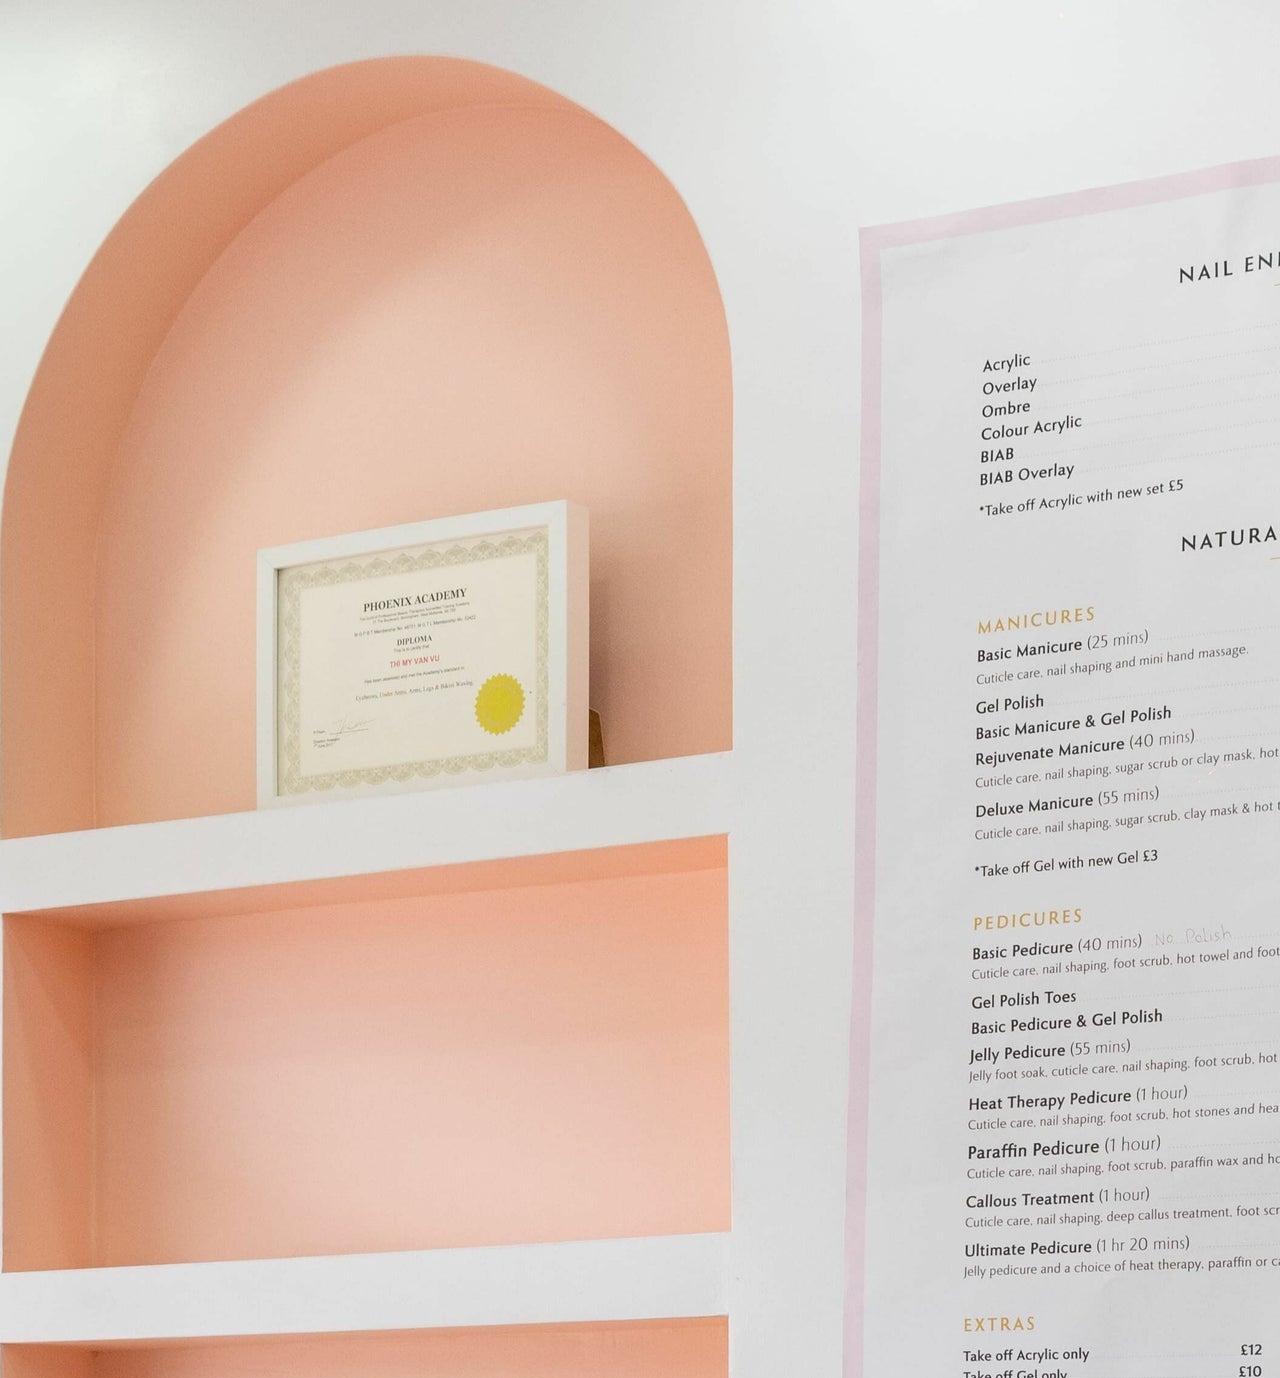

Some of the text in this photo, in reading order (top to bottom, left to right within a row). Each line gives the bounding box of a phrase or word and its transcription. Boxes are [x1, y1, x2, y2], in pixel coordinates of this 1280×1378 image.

[1179, 260, 1234, 284] NAIL
[982, 353, 1031, 374] Acrylic
[982, 376, 1038, 396] Overlay
[982, 400, 1031, 418] Ombre
[981, 415, 1082, 441] Colour Acrylic
[980, 447, 1014, 464] BIAB
[980, 462, 1075, 486] BIAB Overlay
[363, 596, 413, 613] PHOENIX
[414, 588, 468, 605] ACADEMY
[977, 606, 1095, 635] MANICURES
[396, 634, 433, 646] DIPLOMA
[977, 628, 1149, 663] Basic Manicure (25 mins)
[414, 657, 429, 665] VAN
[976, 670, 1014, 685] Cuticle
[1047, 663, 1067, 677] nail
[1070, 662, 1113, 676] shaping
[1114, 655, 1136, 670] and
[1139, 656, 1163, 666] mini
[1167, 648, 1195, 663] hand
[975, 693, 1044, 715] Gel Polish
[976, 705, 1172, 740] Basic Manicure & Gel Polish
[975, 728, 1195, 769] Rejuvenate Manicure (40 mins)
[973, 908, 1082, 931] PEDICURES
[1185, 923, 1232, 944] Polish
[972, 933, 1142, 961] Basic Pedicure (40 mins)
[971, 990, 1077, 1010] Gel Polish Toes
[965, 1186, 1150, 1209] Callous Treatment (1 hour)
[963, 1316, 1035, 1332] EXTRAS
[963, 1347, 1090, 1364] Take off Acrylic only
[1240, 1343, 1263, 1356] £12
